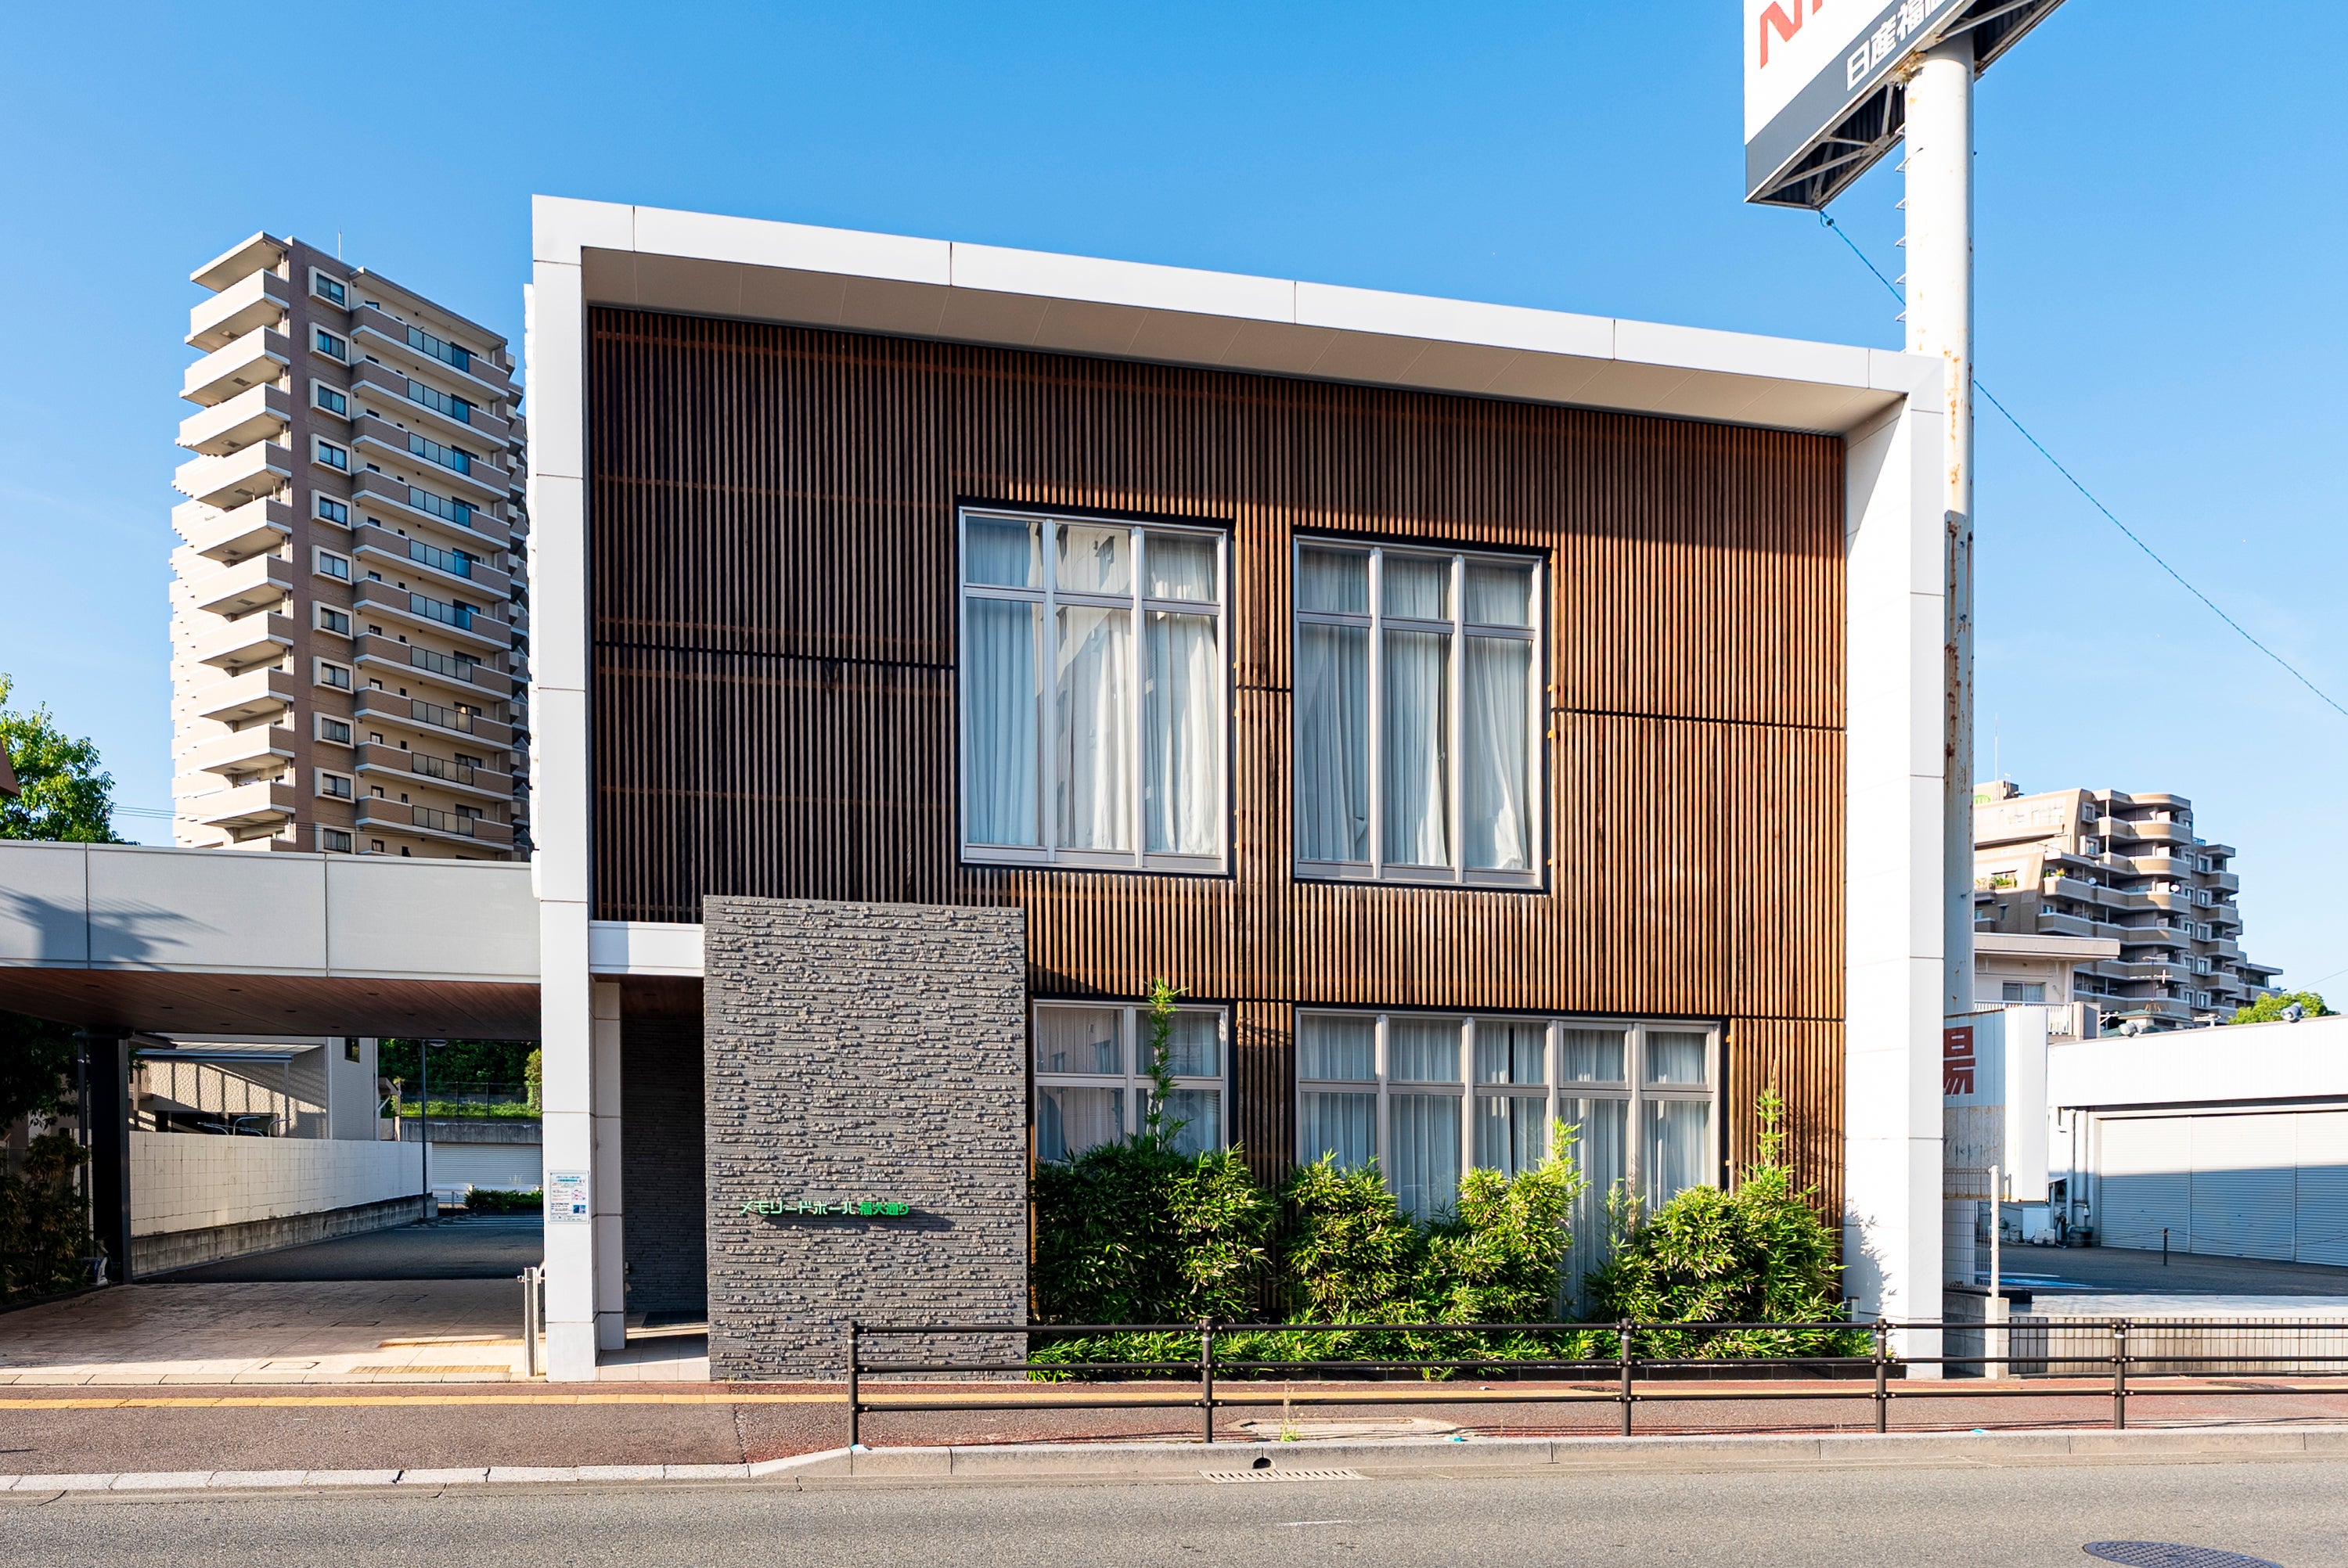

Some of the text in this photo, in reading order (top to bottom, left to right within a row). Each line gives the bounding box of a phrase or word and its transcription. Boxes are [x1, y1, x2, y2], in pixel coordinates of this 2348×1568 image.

[1760, 0, 1822, 69] N
[1847, 0, 1944, 92] 日産福
[740, 1200, 909, 1215] メモリードホール 福大通り
